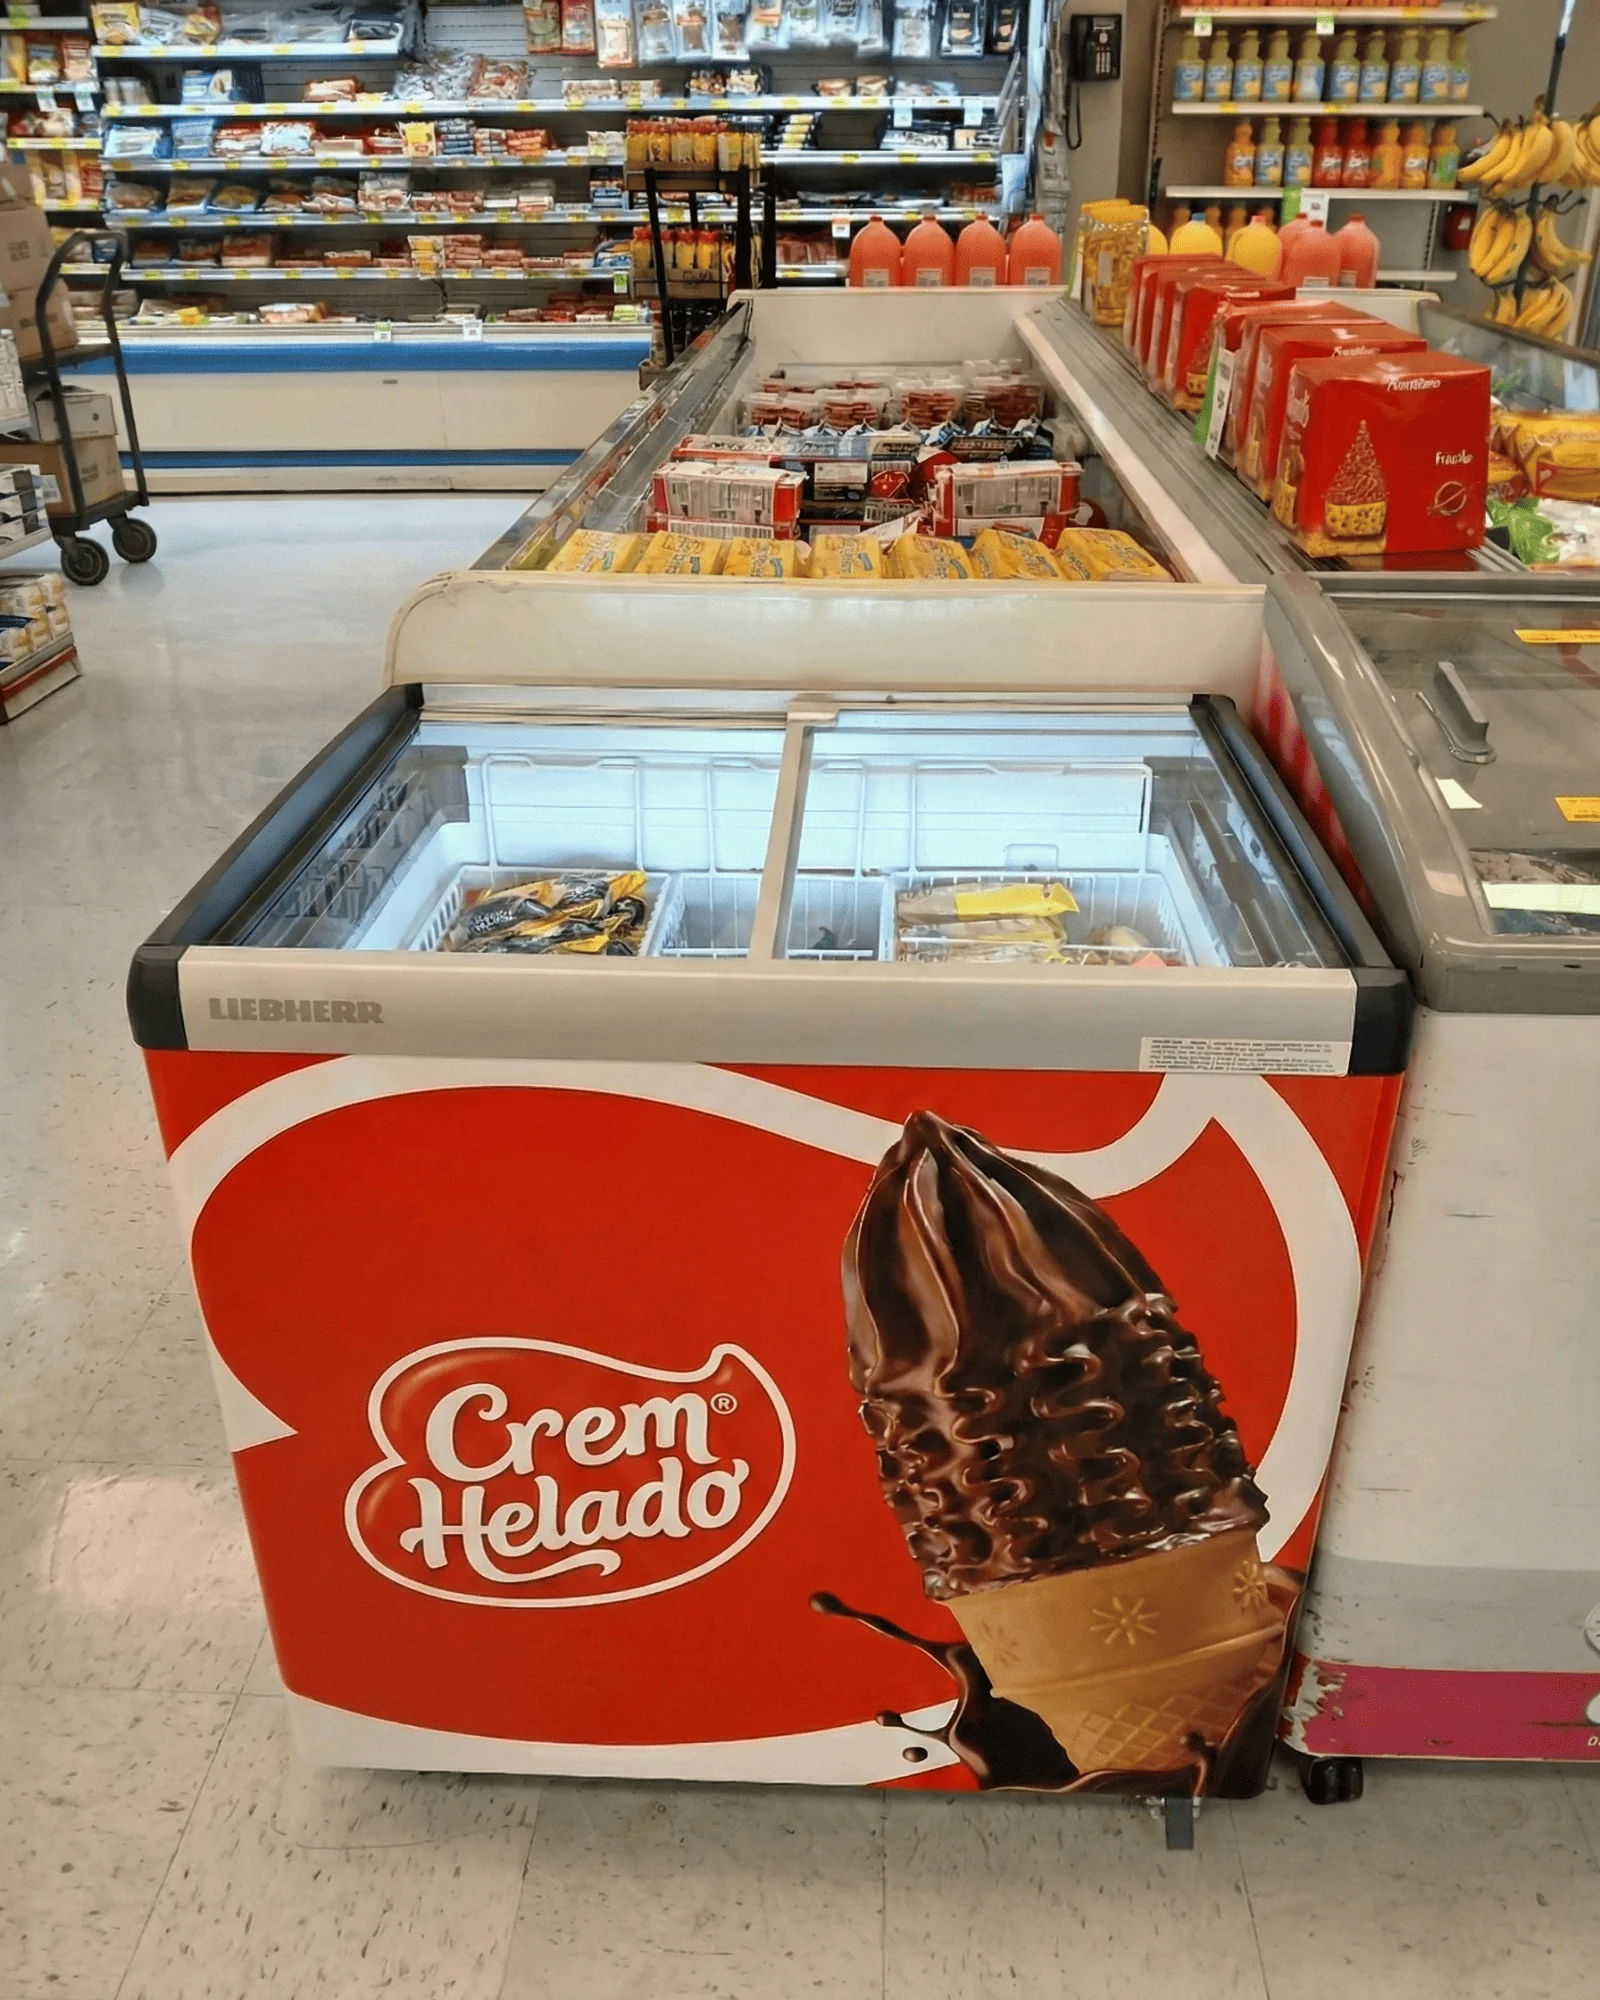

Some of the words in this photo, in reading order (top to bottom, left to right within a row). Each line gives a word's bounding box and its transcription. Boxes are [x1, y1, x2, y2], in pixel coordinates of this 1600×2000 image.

[208, 997, 385, 1024] LIEBHERR
[426, 1382, 721, 1483] Crem
[400, 1456, 750, 1583] Helado
